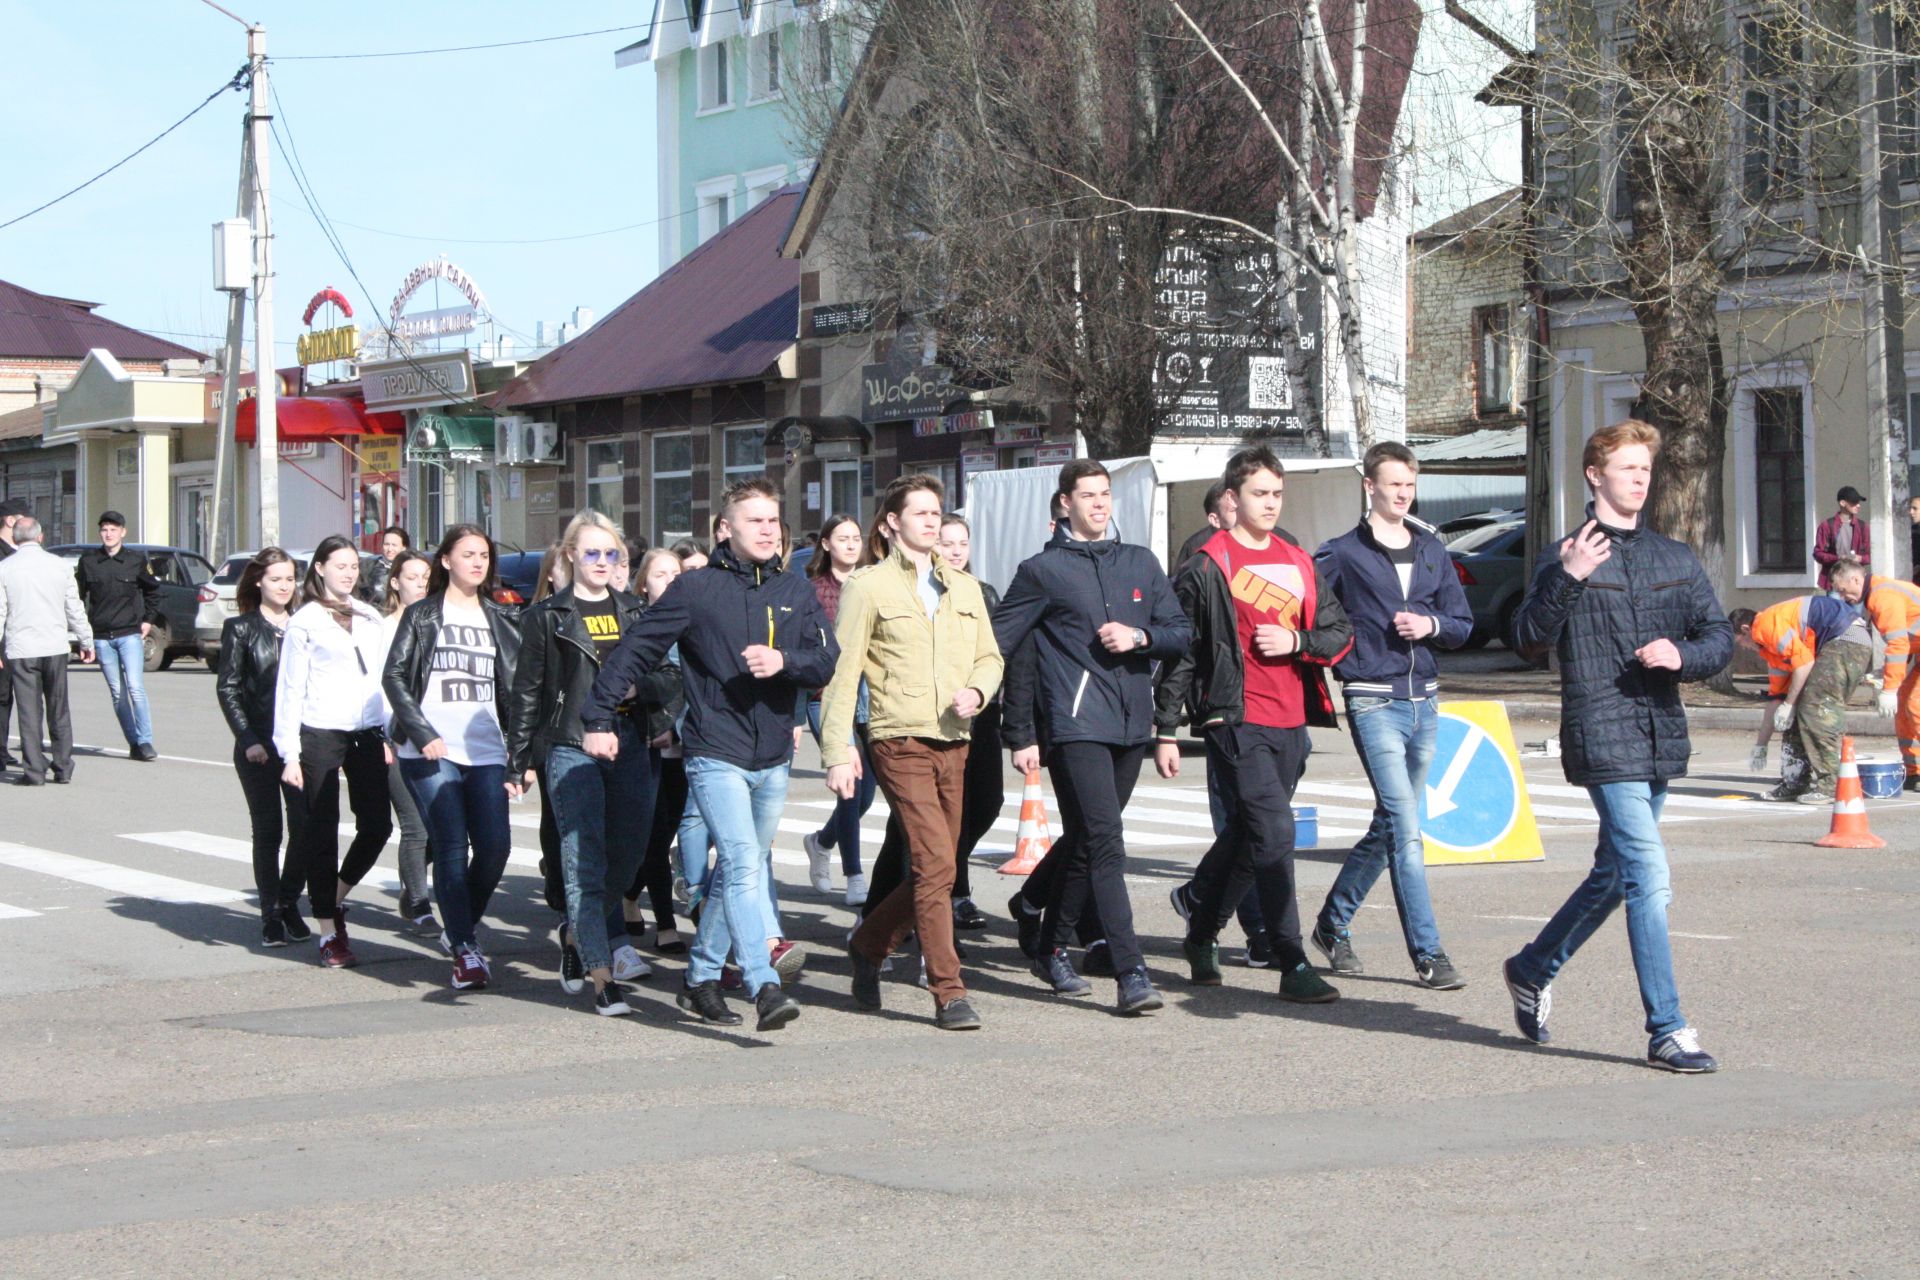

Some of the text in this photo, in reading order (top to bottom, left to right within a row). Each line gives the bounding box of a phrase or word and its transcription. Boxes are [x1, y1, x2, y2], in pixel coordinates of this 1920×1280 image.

[447, 263, 480, 310] САЛОН
[382, 368, 451, 396] ПРОДУКТЫ
[1230, 567, 1301, 630] UFC
[582, 615, 619, 634] RVA
[450, 625, 491, 648] YOU
[475, 656, 495, 679] WH
[449, 683, 492, 702] TO DO
